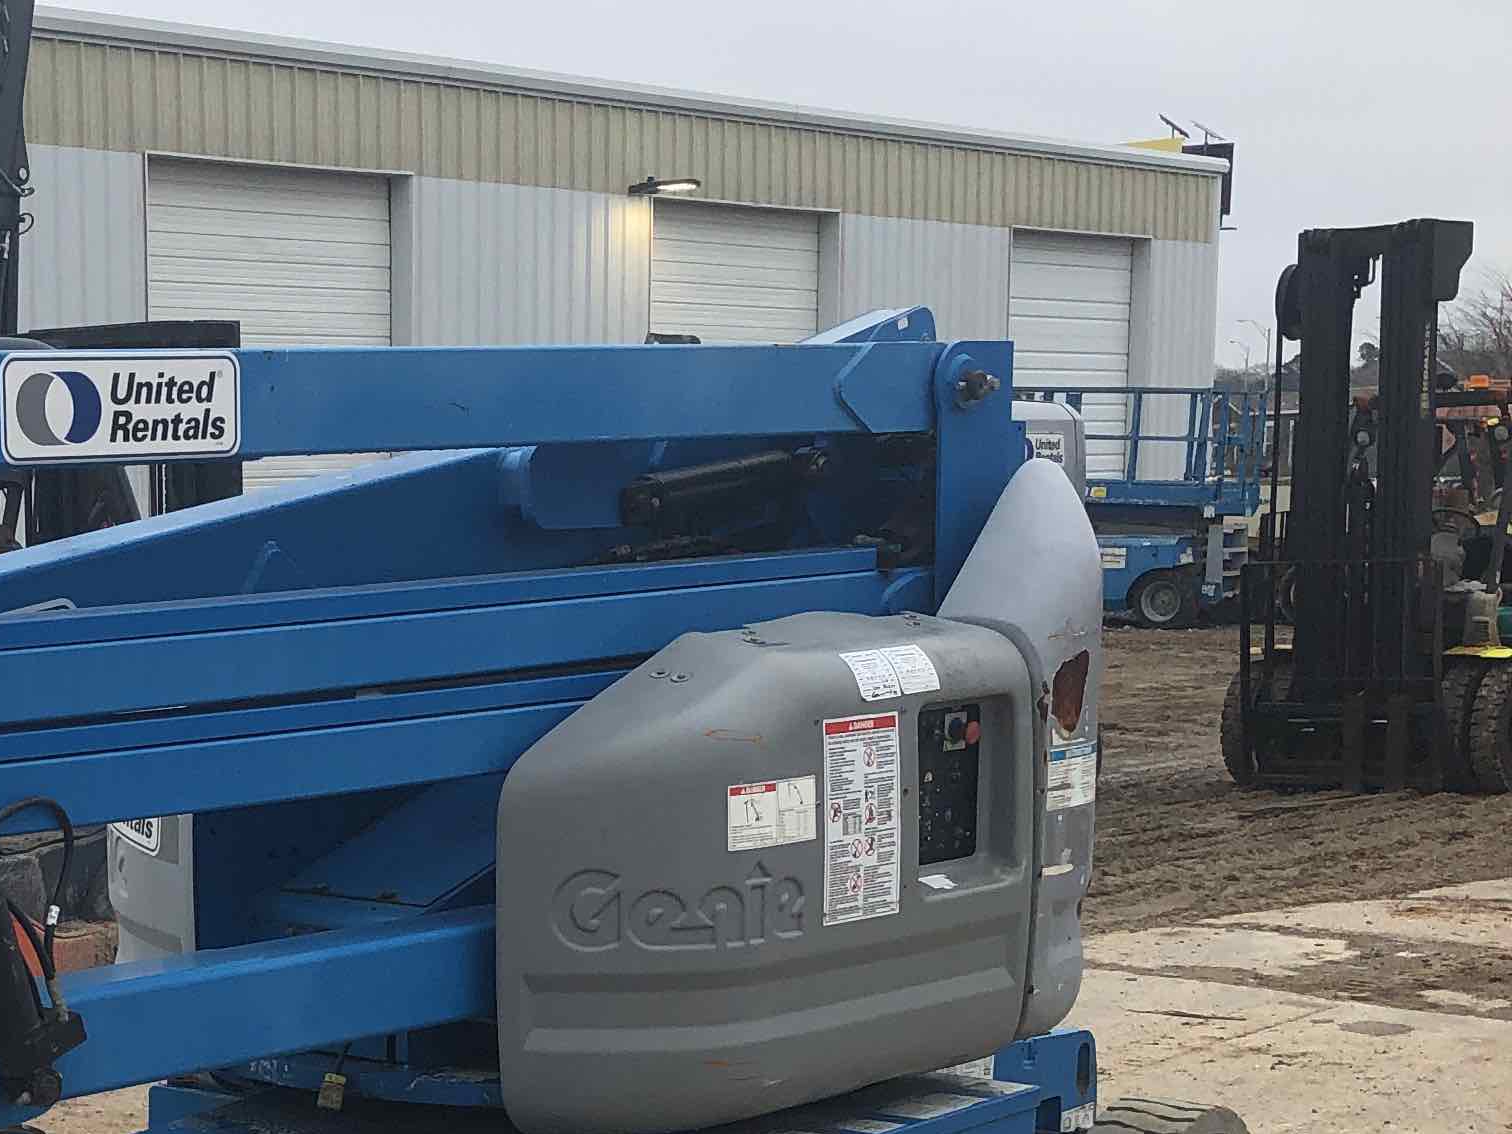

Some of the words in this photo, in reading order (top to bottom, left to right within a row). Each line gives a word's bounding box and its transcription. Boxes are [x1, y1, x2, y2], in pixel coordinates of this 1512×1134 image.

[110, 371, 216, 405] United
[109, 408, 226, 443] Rentals
[550, 860, 805, 951] Genie
